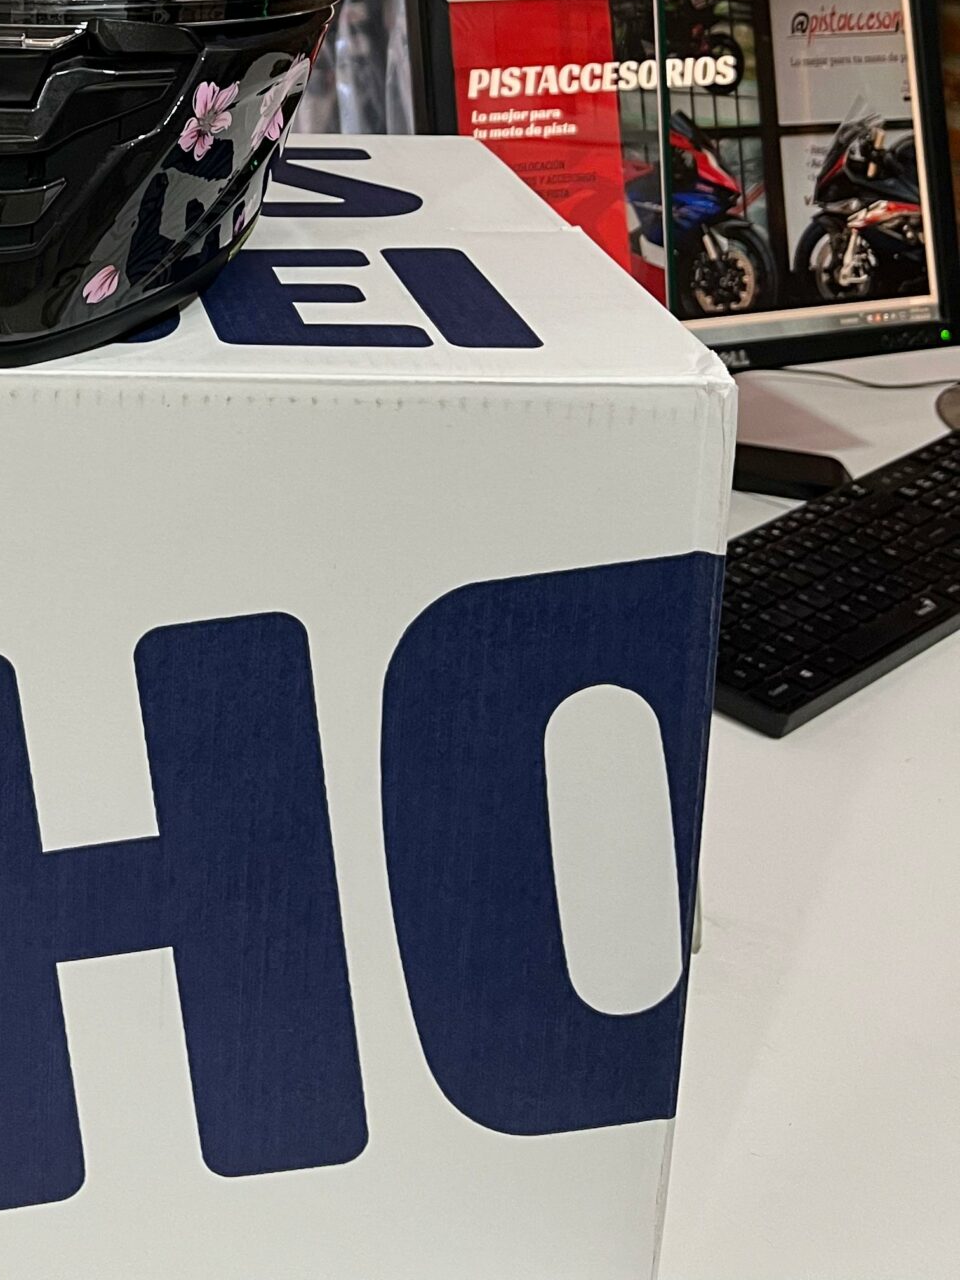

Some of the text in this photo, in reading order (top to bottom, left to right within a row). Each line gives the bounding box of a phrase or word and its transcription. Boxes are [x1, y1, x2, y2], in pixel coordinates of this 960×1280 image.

[467, 55, 738, 100] PISTACCESORIOS
[471, 108, 562, 125] Lo mejor para
[473, 122, 577, 139] tu moto de pista
